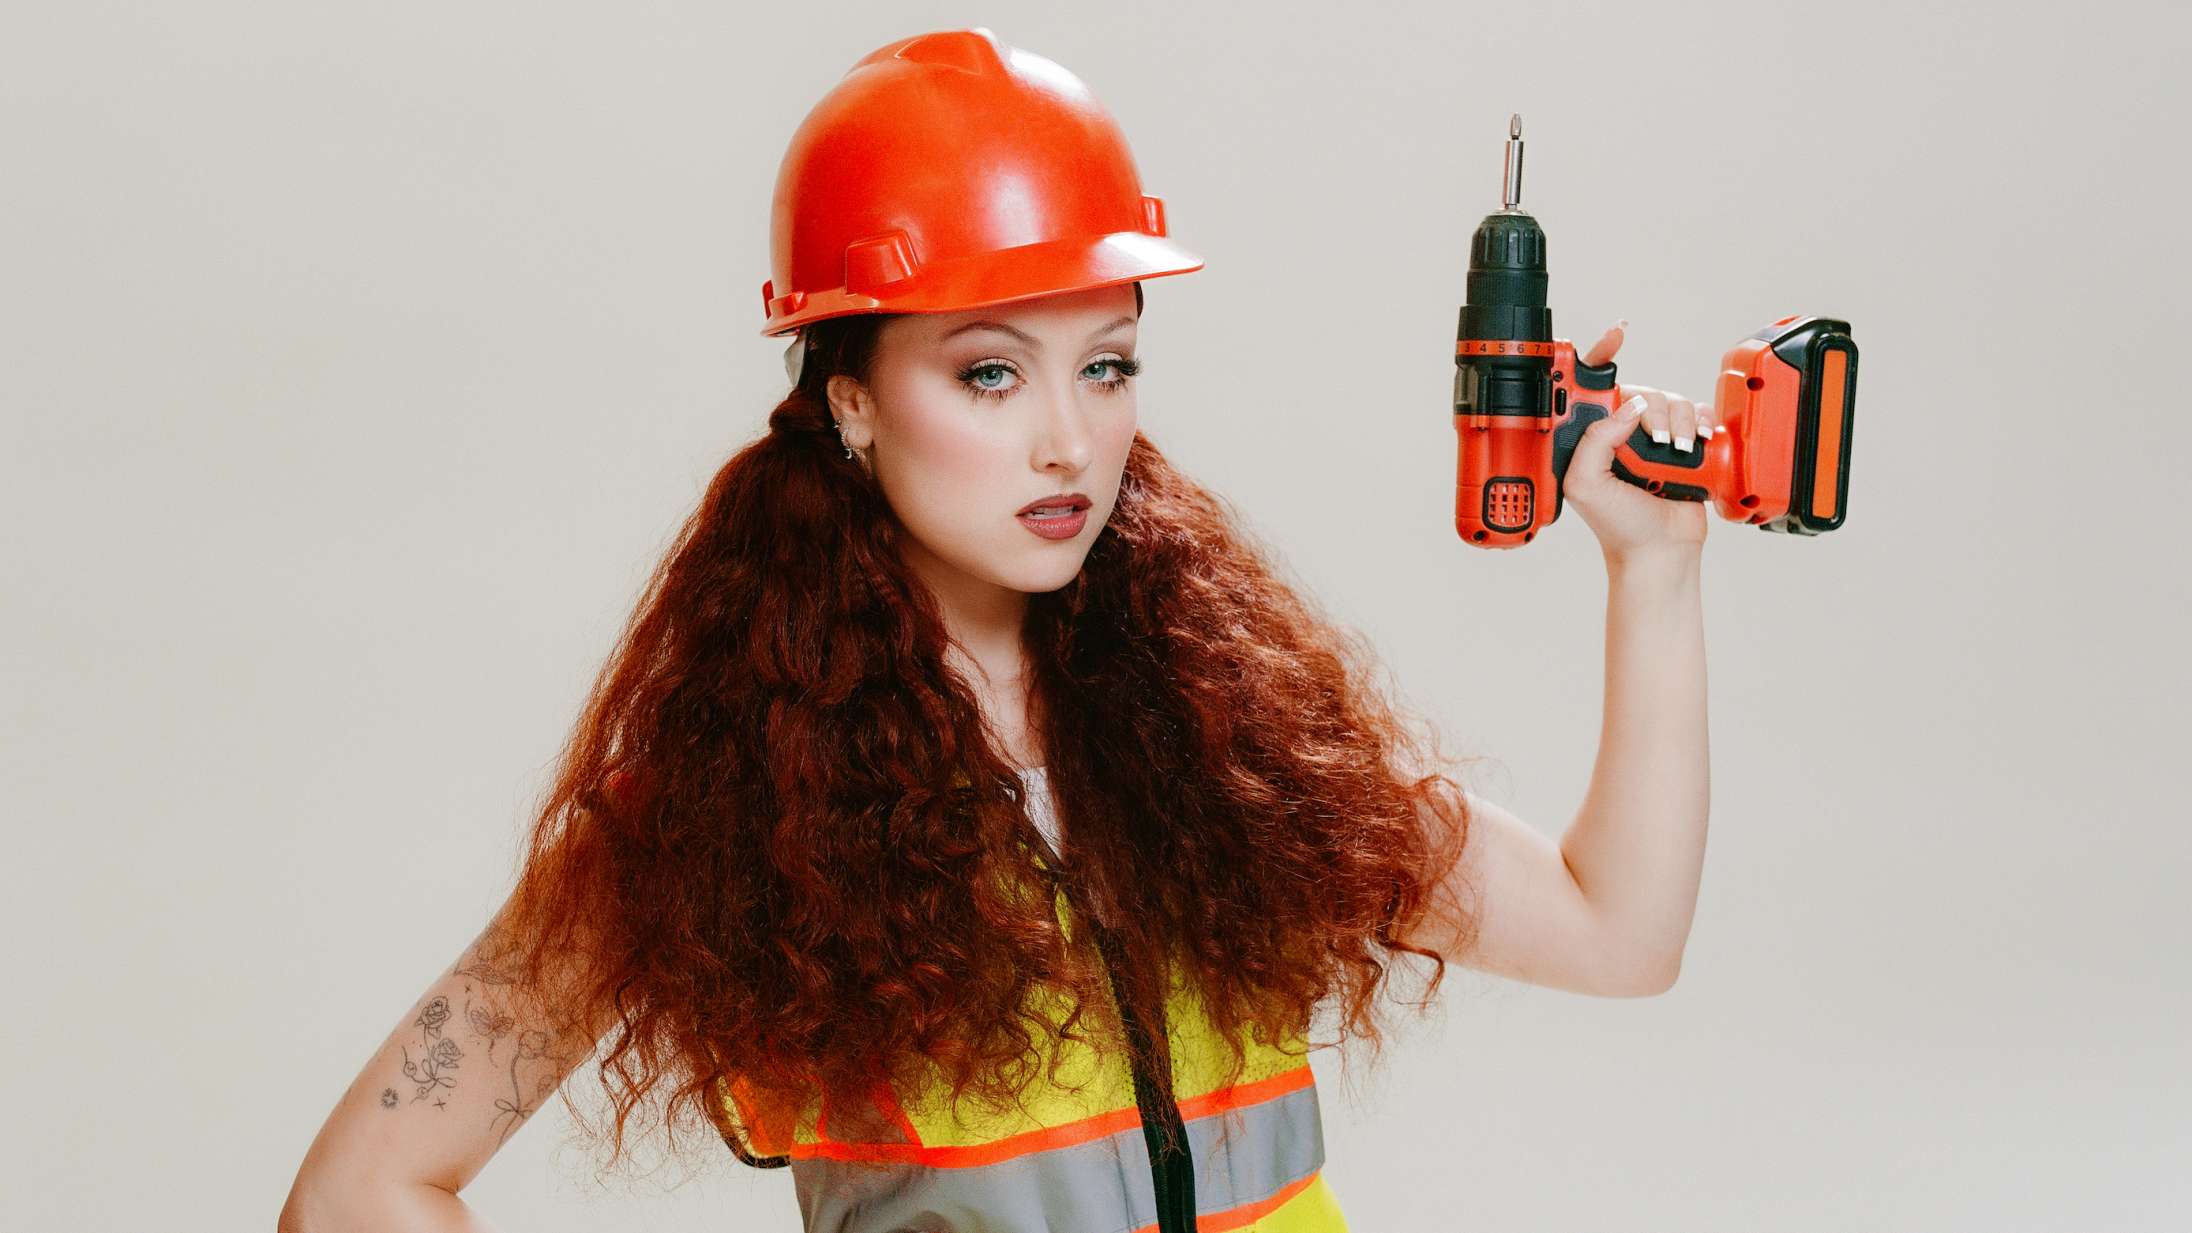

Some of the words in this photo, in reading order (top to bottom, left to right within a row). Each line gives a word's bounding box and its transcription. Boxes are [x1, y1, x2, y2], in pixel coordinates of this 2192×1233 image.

[1480, 343, 1486, 352] 4
[1498, 343, 1505, 353] 5
[1517, 343, 1524, 353] 6
[1535, 344, 1541, 354] 7
